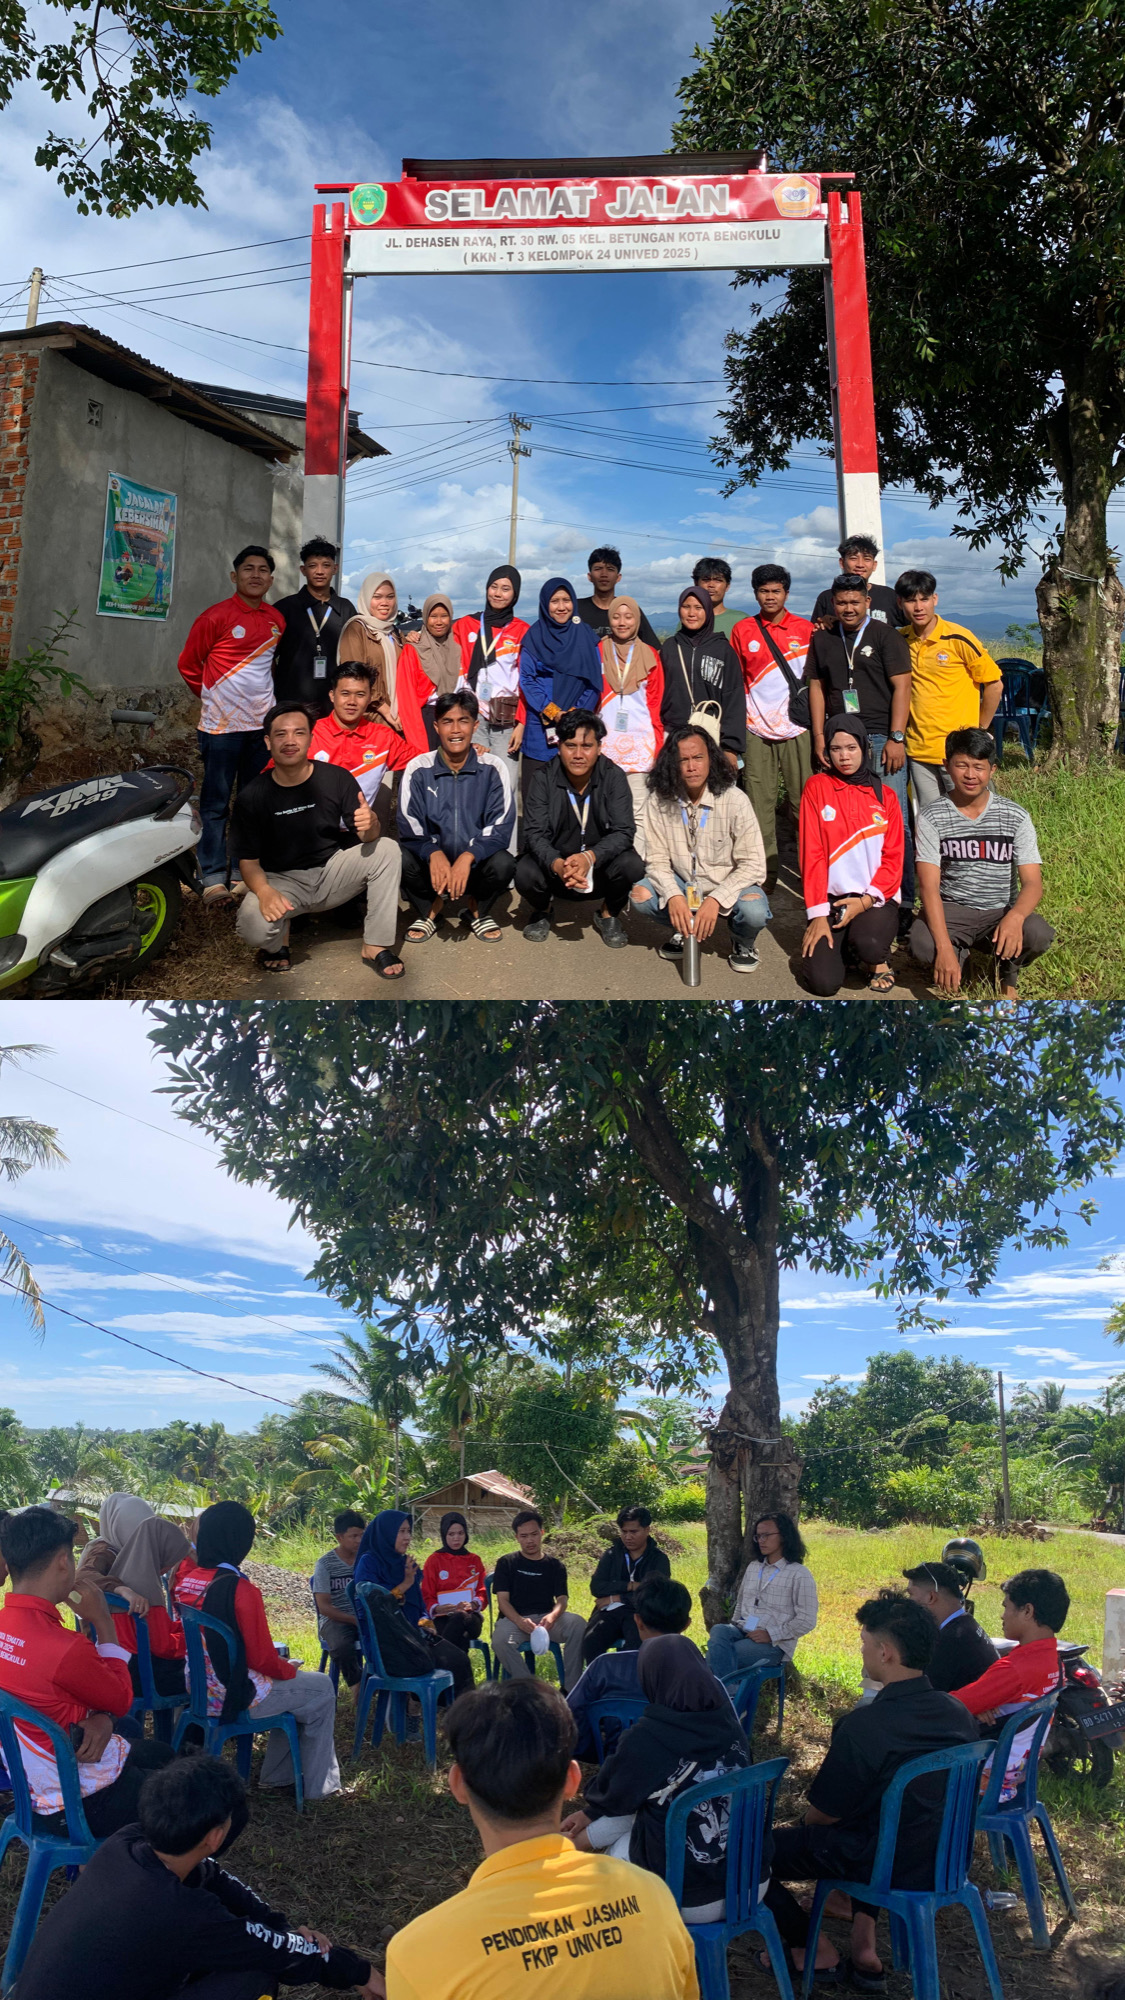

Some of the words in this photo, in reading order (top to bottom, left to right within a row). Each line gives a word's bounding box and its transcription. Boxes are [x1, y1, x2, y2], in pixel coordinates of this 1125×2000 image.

[426, 187, 596, 220] SELAMAT
[606, 184, 729, 218] JALAN
[385, 237, 402, 248] JL.
[405, 236, 460, 248] DEHASEN
[463, 236, 497, 248] RAYA,
[500, 235, 517, 247] RT.
[520, 235, 534, 246] 30
[537, 234, 558, 246] RW.
[561, 233, 576, 244] 05
[579, 233, 606, 244] KEL.
[609, 231, 675, 244] BETUNGAN
[678, 231, 710, 242] KOTA
[714, 229, 781, 241] BENGKULU
[471, 251, 497, 262] KKN
[507, 251, 514, 262] T
[517, 251, 525, 262] 3
[528, 250, 593, 262] KELOMPOK
[596, 249, 611, 260] 24
[614, 248, 659, 260] UNIVED
[663, 247, 691, 259] 2025
[1083, 1717, 1094, 1728] BD
[481, 1914, 576, 1956] PENDIDIKAN
[582, 1894, 641, 1927] JASMANI
[521, 1944, 559, 1972] FKIP
[566, 1925, 623, 1959] UNIVED
